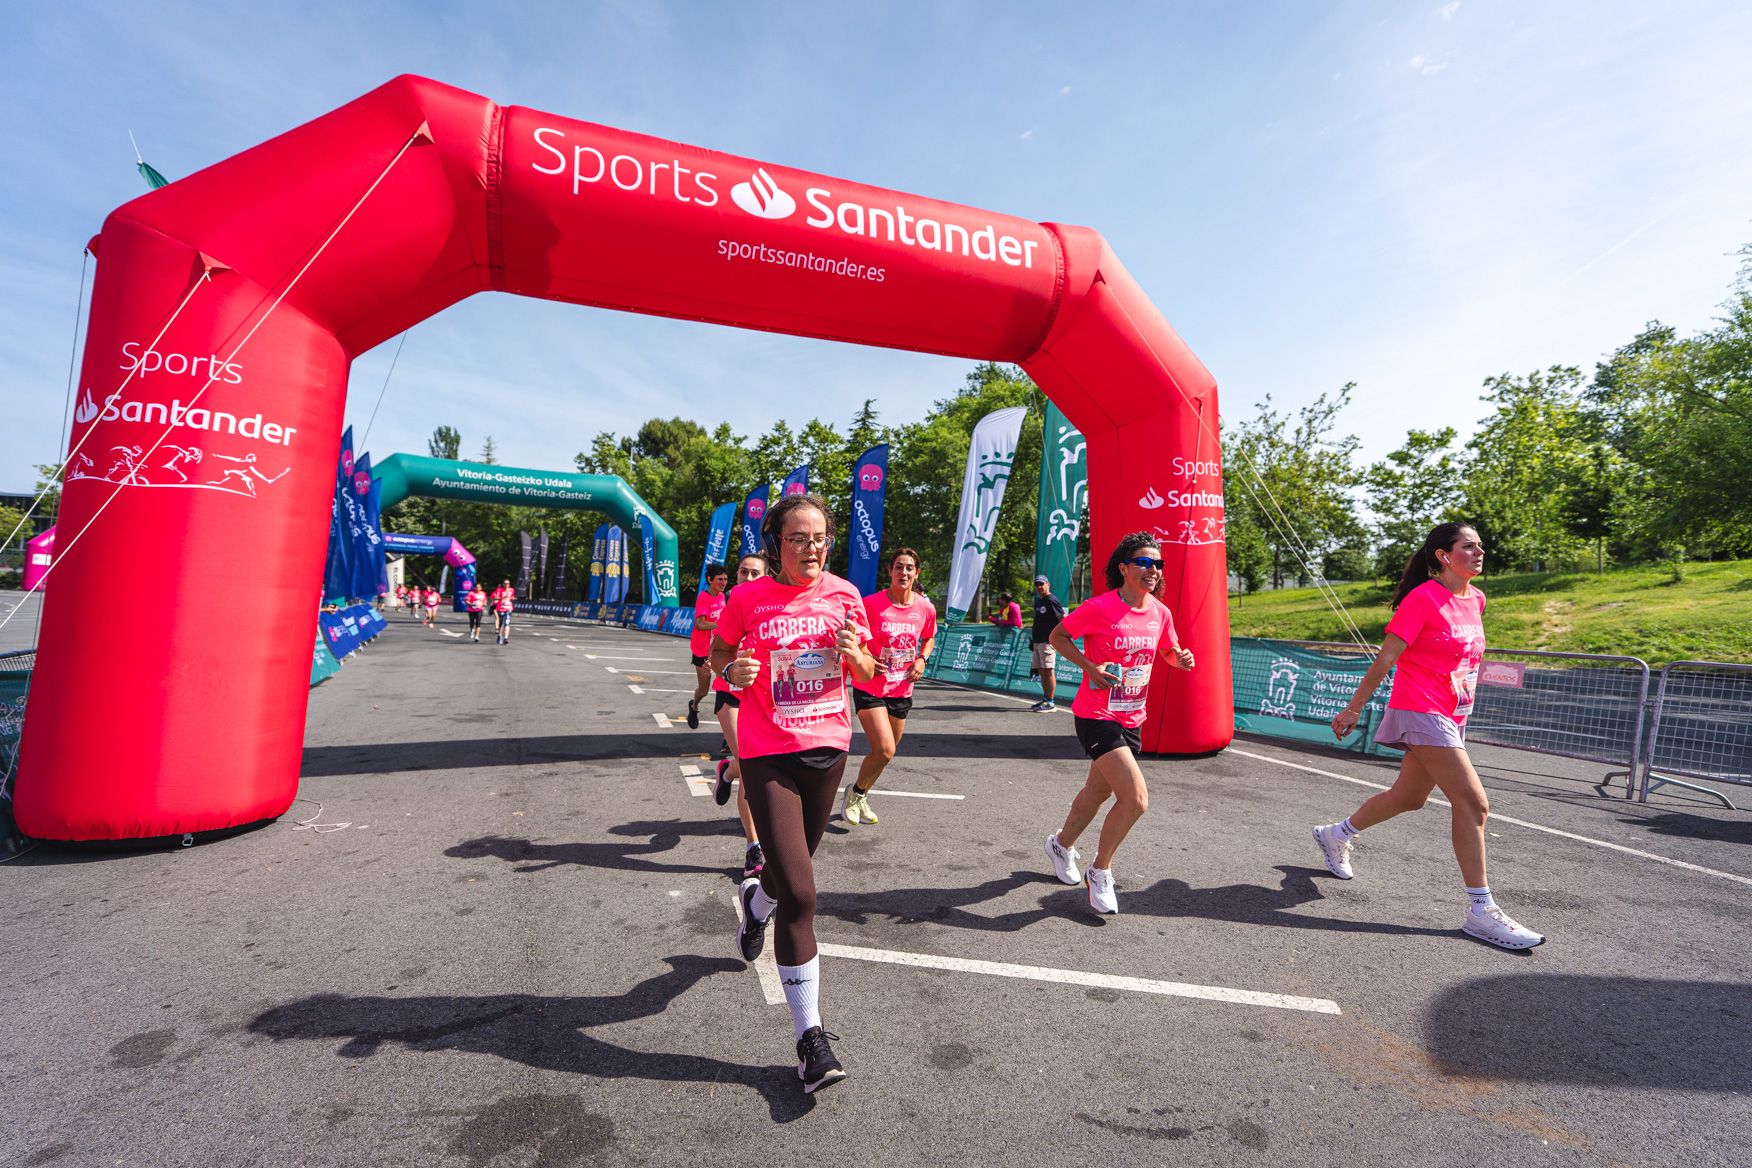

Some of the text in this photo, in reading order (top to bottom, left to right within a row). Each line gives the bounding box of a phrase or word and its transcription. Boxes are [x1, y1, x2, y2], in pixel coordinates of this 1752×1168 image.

[531, 127, 1039, 269] Sports Santander
[717, 238, 886, 283] sportssantander.es
[119, 341, 243, 384] Sports
[102, 393, 297, 446] Santander
[456, 468, 573, 489] Vitoria-Gasteizko Udala
[1172, 456, 1220, 480] Sports
[432, 477, 592, 501] Ayuntamiento de Vitoria-Gasteiz
[1167, 489, 1225, 508] Santand
[854, 499, 880, 553] octopus
[754, 604, 785, 614] OYSHO
[881, 621, 916, 634] CARRERA
[796, 680, 824, 692] 016
[1125, 686, 1141, 694] 016
[1312, 681, 1327, 692] de
